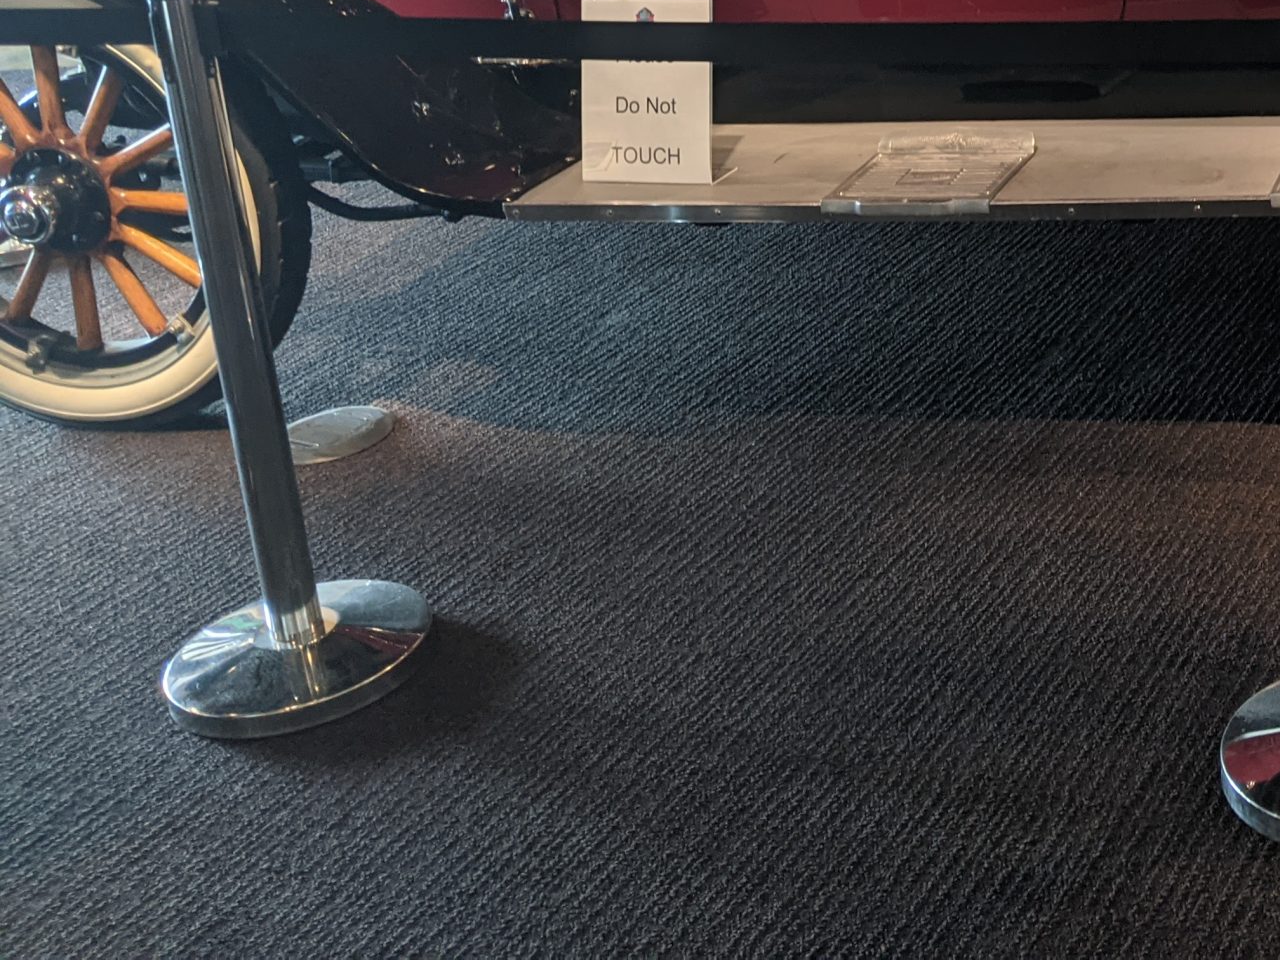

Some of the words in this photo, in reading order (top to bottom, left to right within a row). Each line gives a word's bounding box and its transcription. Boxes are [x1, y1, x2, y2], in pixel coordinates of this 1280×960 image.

[616, 96, 640, 114] Do
[646, 96, 677, 115] Not
[611, 146, 681, 166] TOUCH
